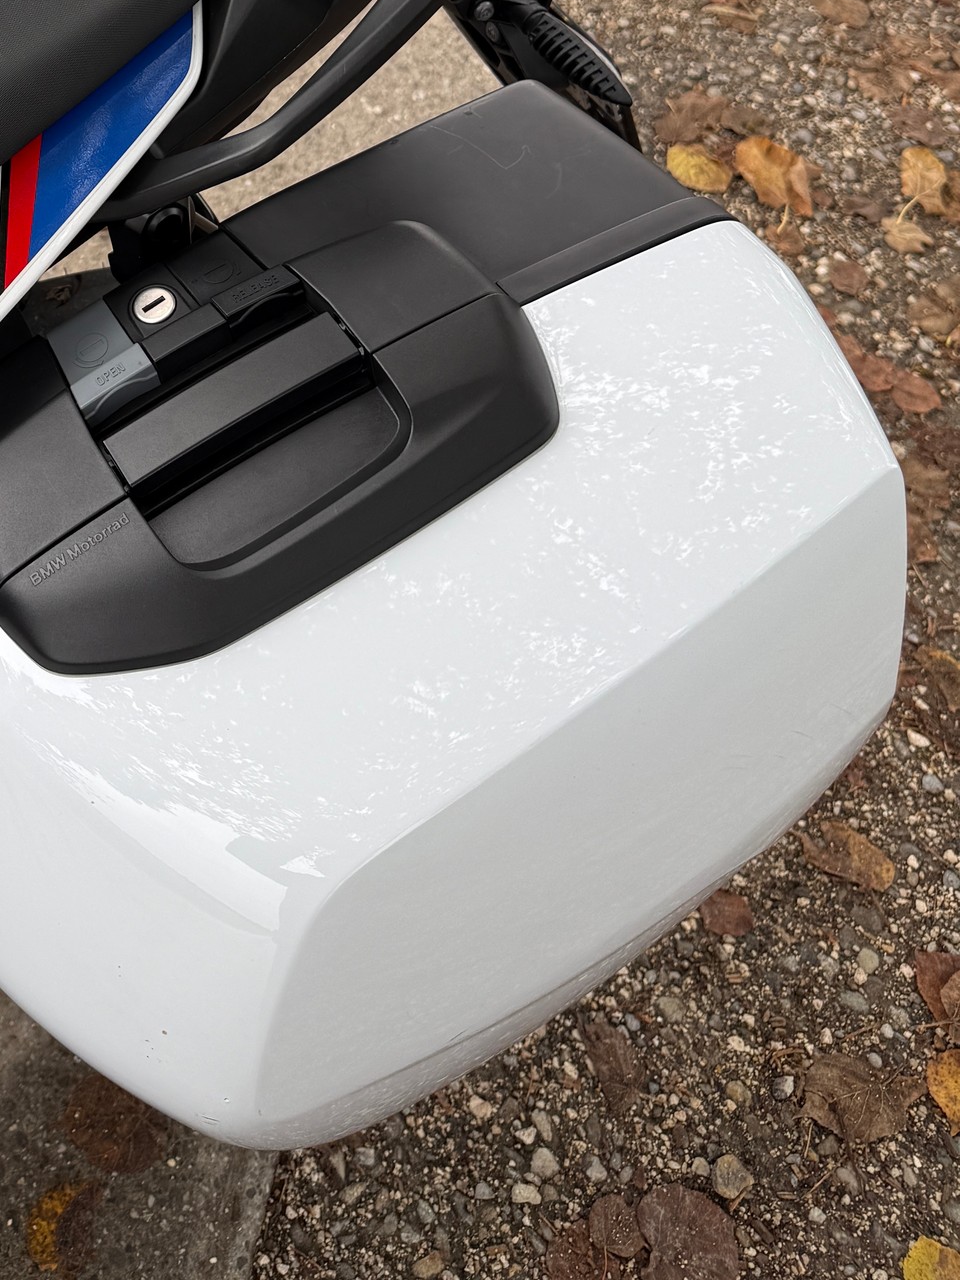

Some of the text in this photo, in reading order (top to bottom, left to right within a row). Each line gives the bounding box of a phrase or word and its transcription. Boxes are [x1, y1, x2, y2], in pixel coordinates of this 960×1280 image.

[231, 274, 280, 304] RELEASE
[95, 362, 127, 387] OPEN
[28, 512, 131, 587] BMW Motorrad
